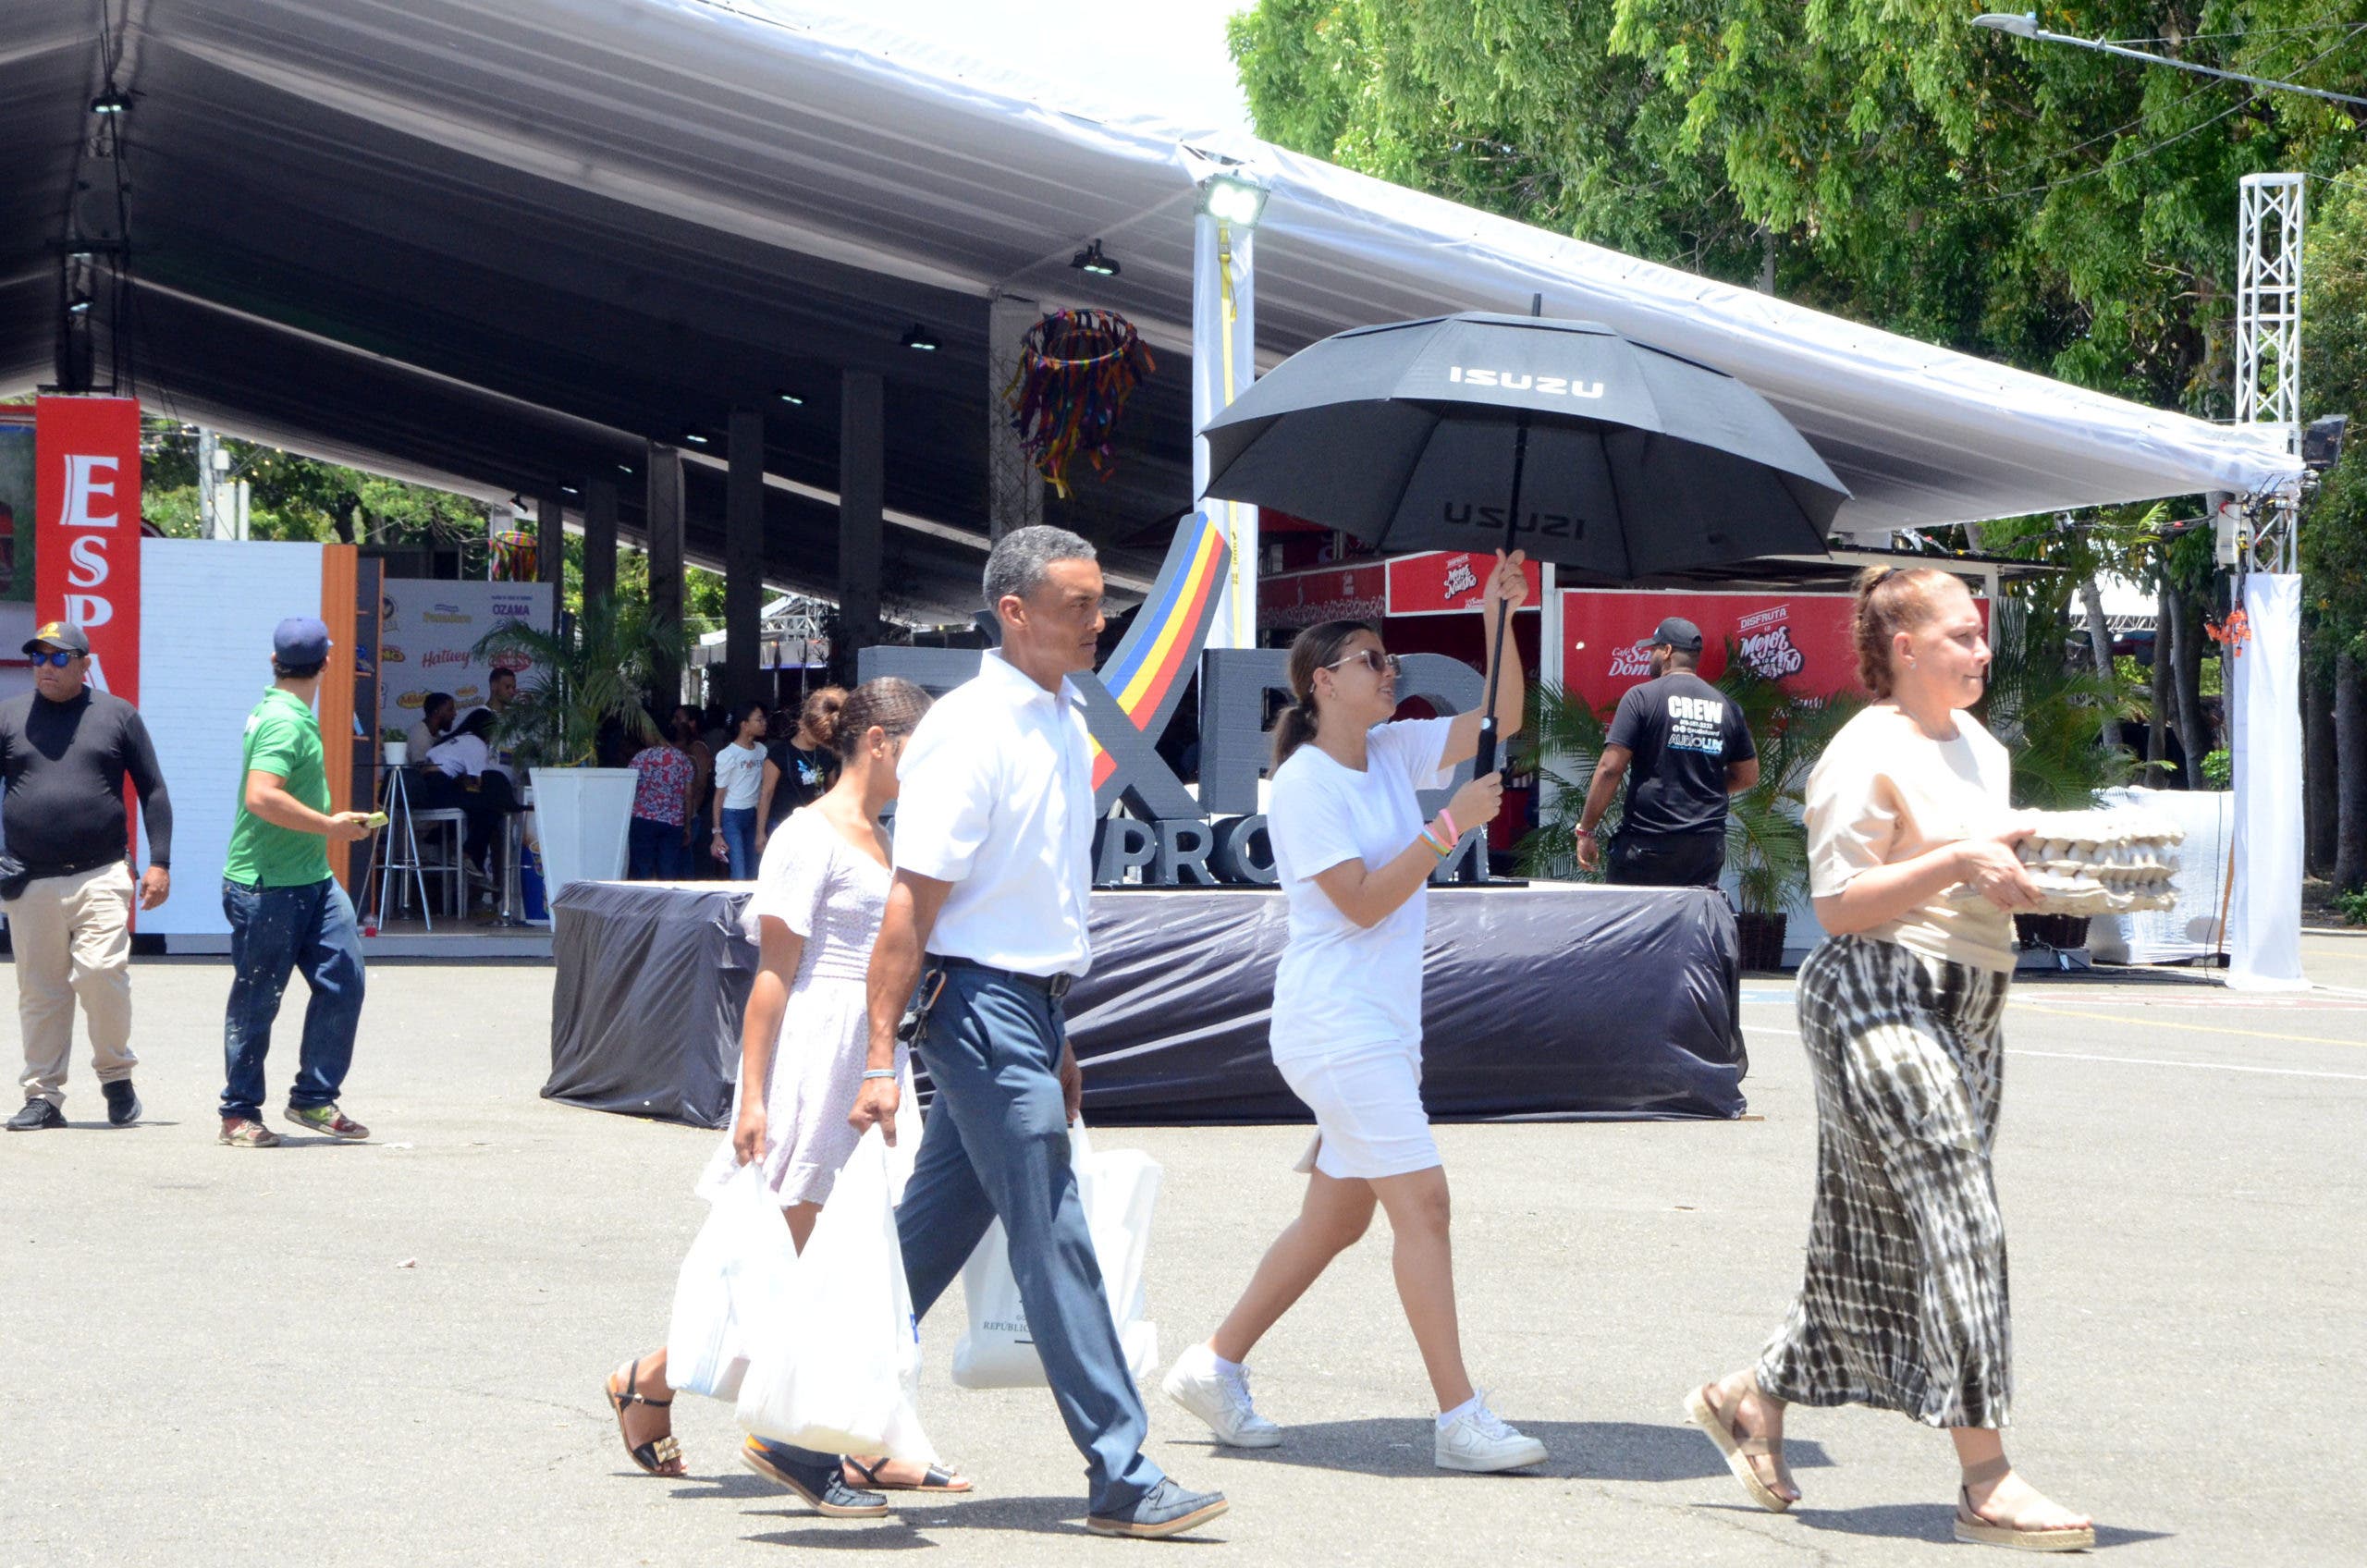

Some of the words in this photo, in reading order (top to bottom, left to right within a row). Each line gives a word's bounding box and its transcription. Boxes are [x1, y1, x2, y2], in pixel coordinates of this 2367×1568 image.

[1450, 366, 1604, 398] ISUZU
[493, 604, 530, 616] OZAMA
[1740, 607, 1787, 629] DISFRUTA
[423, 649, 472, 668] Hatuey
[1612, 647, 1633, 659] Café
[1668, 695, 1723, 724] CREW
[983, 1319, 1028, 1332] REPÚBLIC
